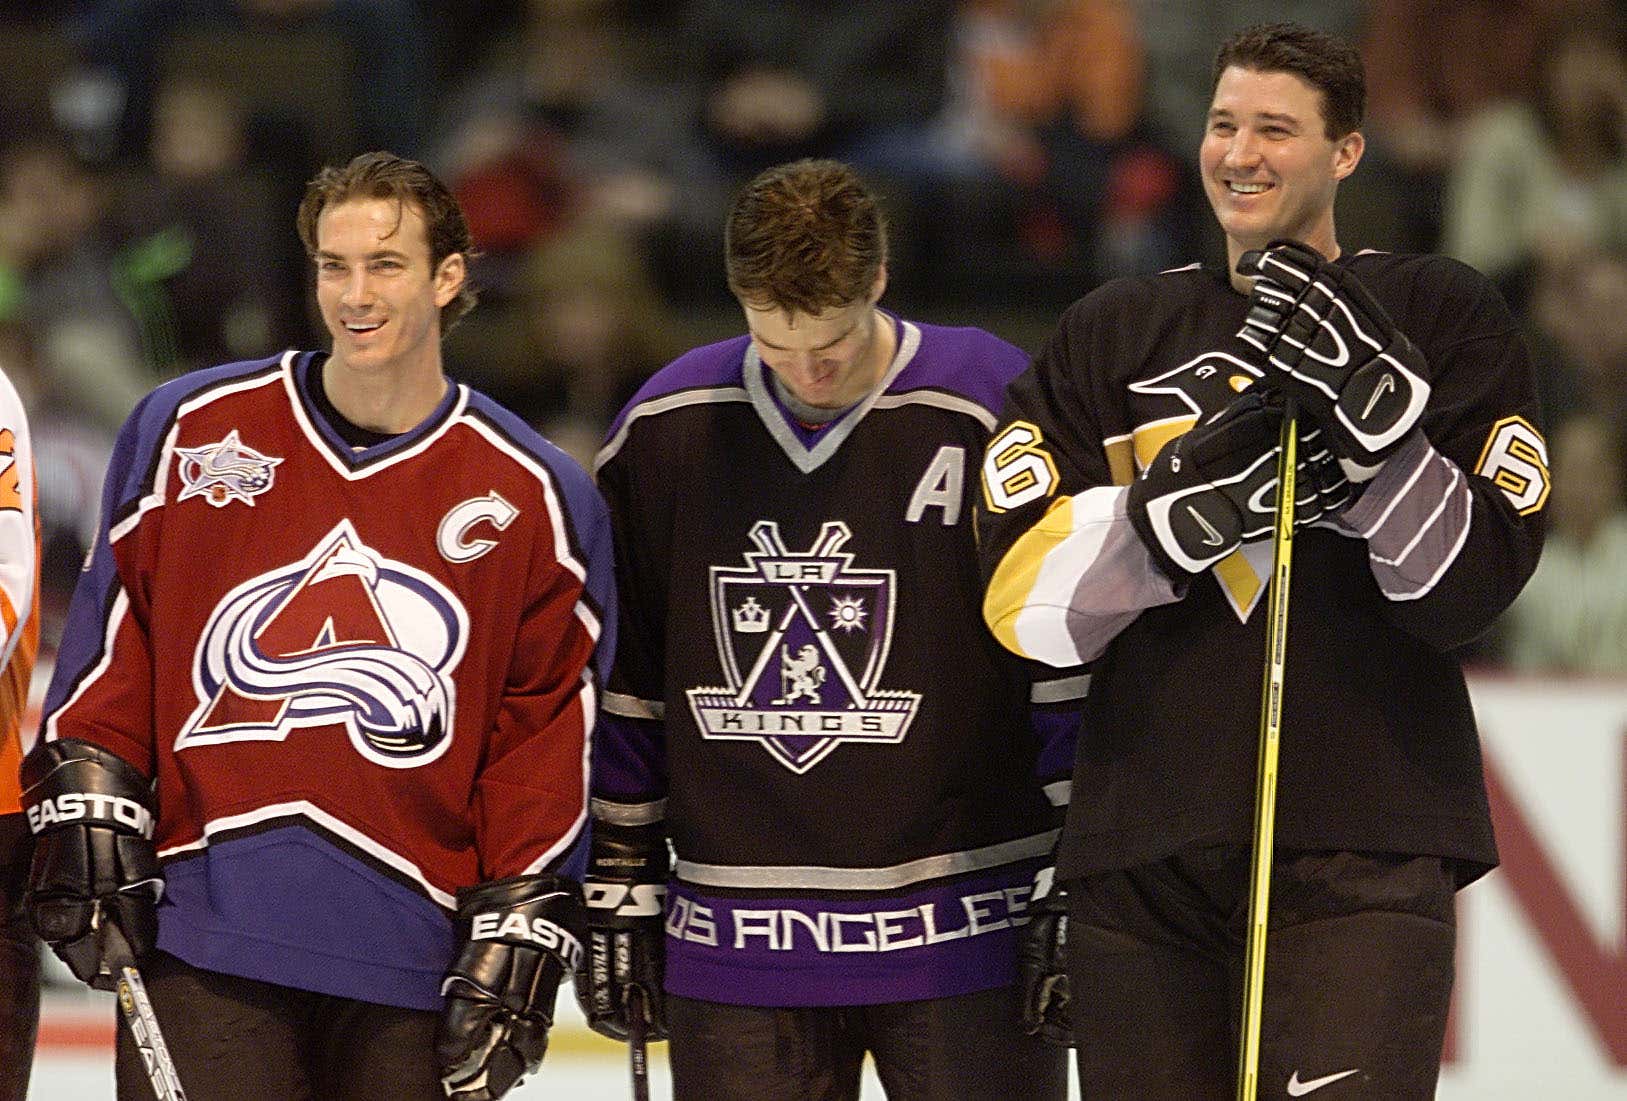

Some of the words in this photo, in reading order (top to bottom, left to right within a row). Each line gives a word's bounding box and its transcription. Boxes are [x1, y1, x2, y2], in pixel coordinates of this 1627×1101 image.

[905, 446, 965, 525] A
[981, 420, 1060, 513] 6
[1473, 415, 1551, 516] 6
[436, 489, 520, 563] C
[774, 564, 824, 580] LA
[721, 713, 882, 732] KINGS
[27, 792, 155, 840] EASTON
[732, 885, 1033, 952] ANGELES
[131, 1016, 172, 1101] EAS
